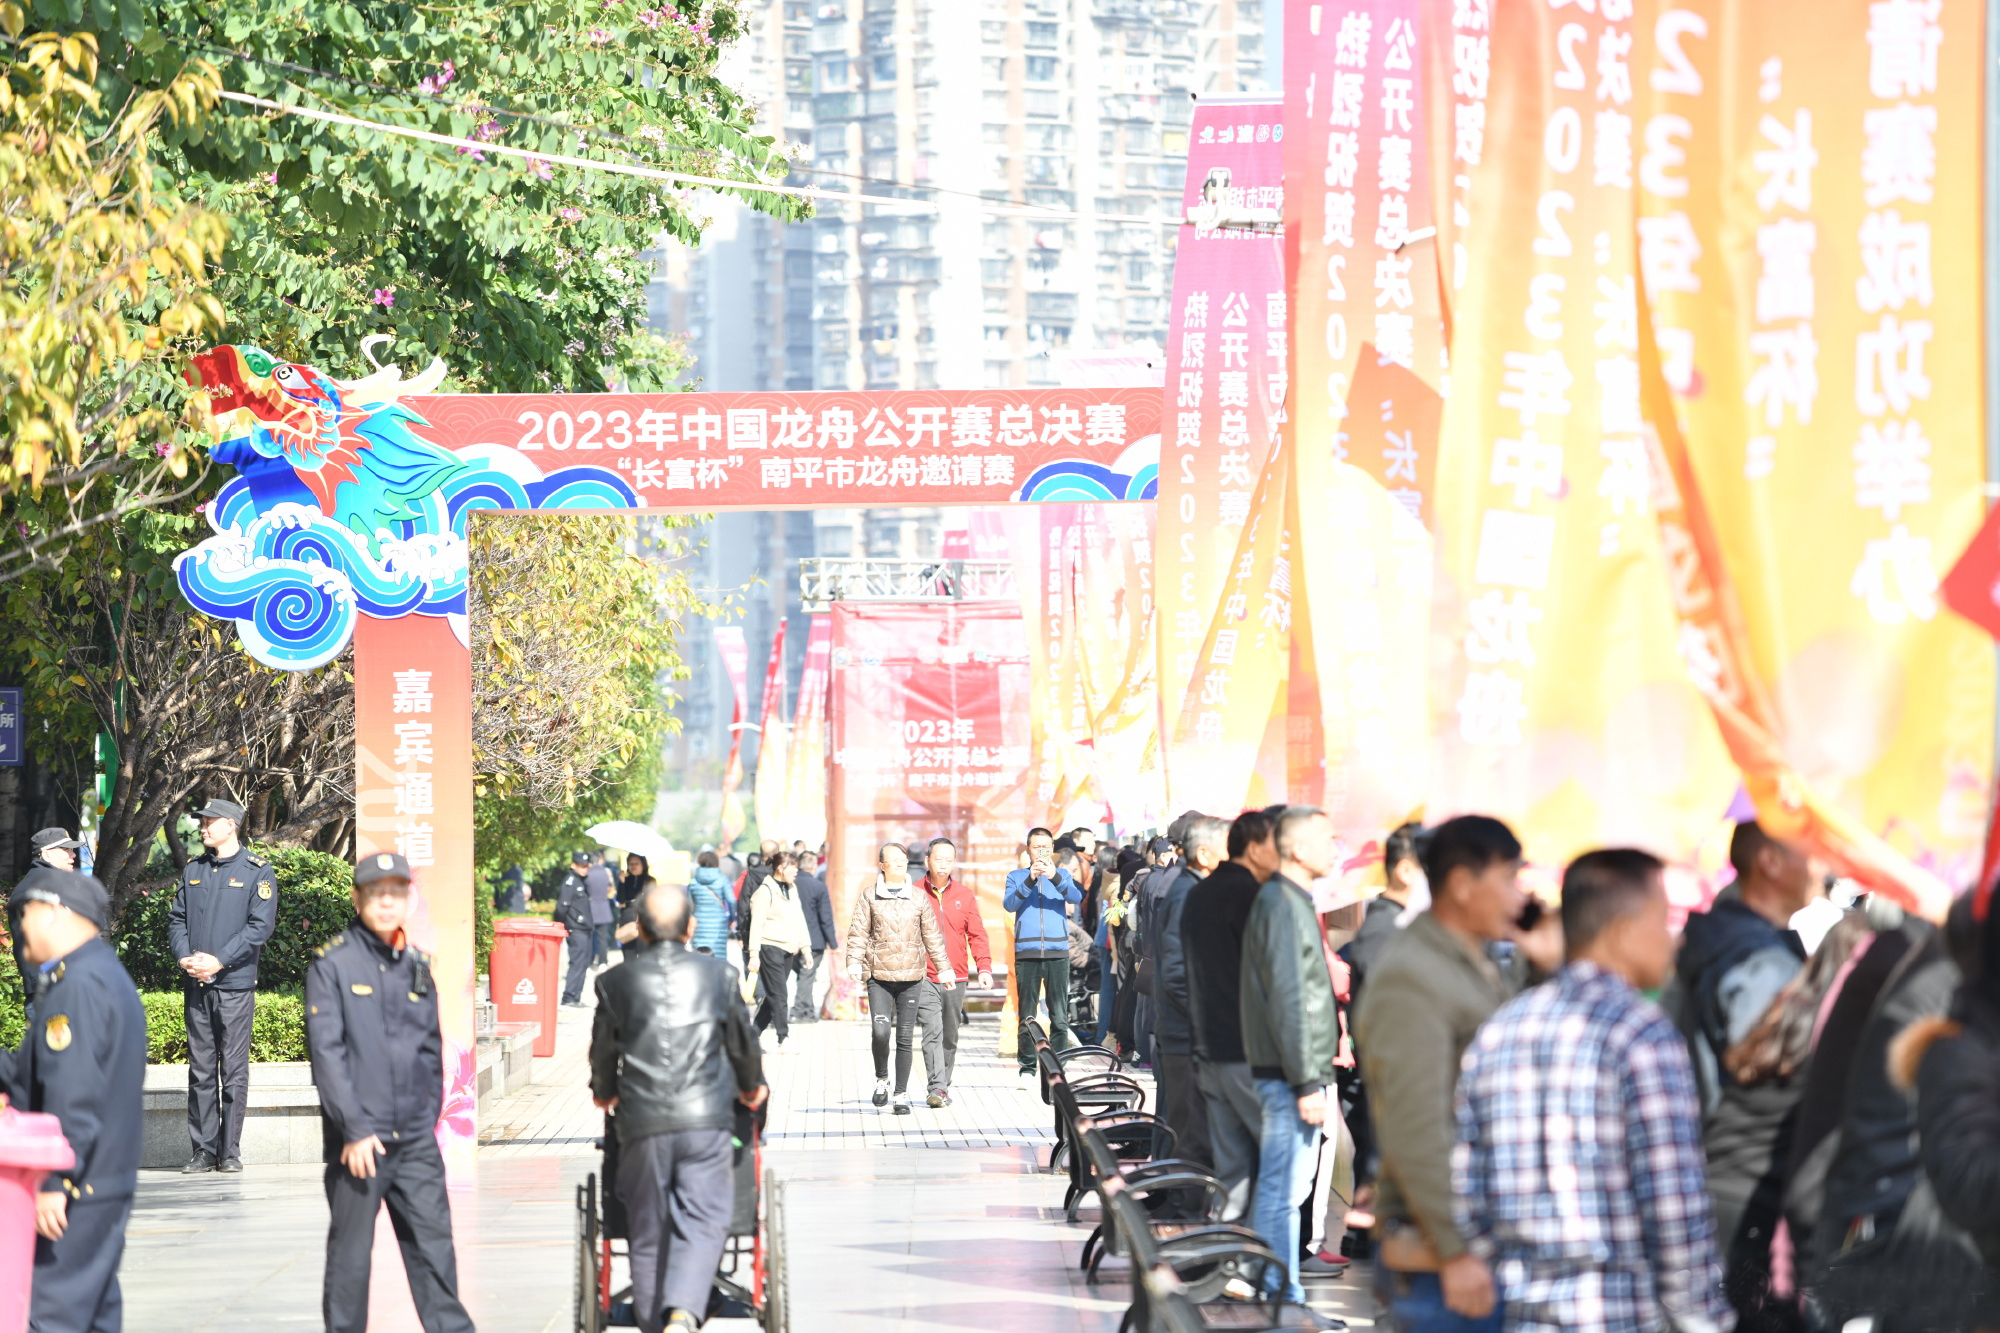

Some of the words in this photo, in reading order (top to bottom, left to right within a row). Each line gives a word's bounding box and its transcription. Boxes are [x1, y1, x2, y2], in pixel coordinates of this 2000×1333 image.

[517, 402, 1126, 450] 2023年中国龙舟公开赛总决赛
[617, 453, 1015, 490] “长富杯”南平市龙舟邀请赛
[888, 717, 976, 744] 2023年
[392, 668, 435, 867] 嘉宾通道
[834, 746, 1031, 769] 中舟公开赛总决
